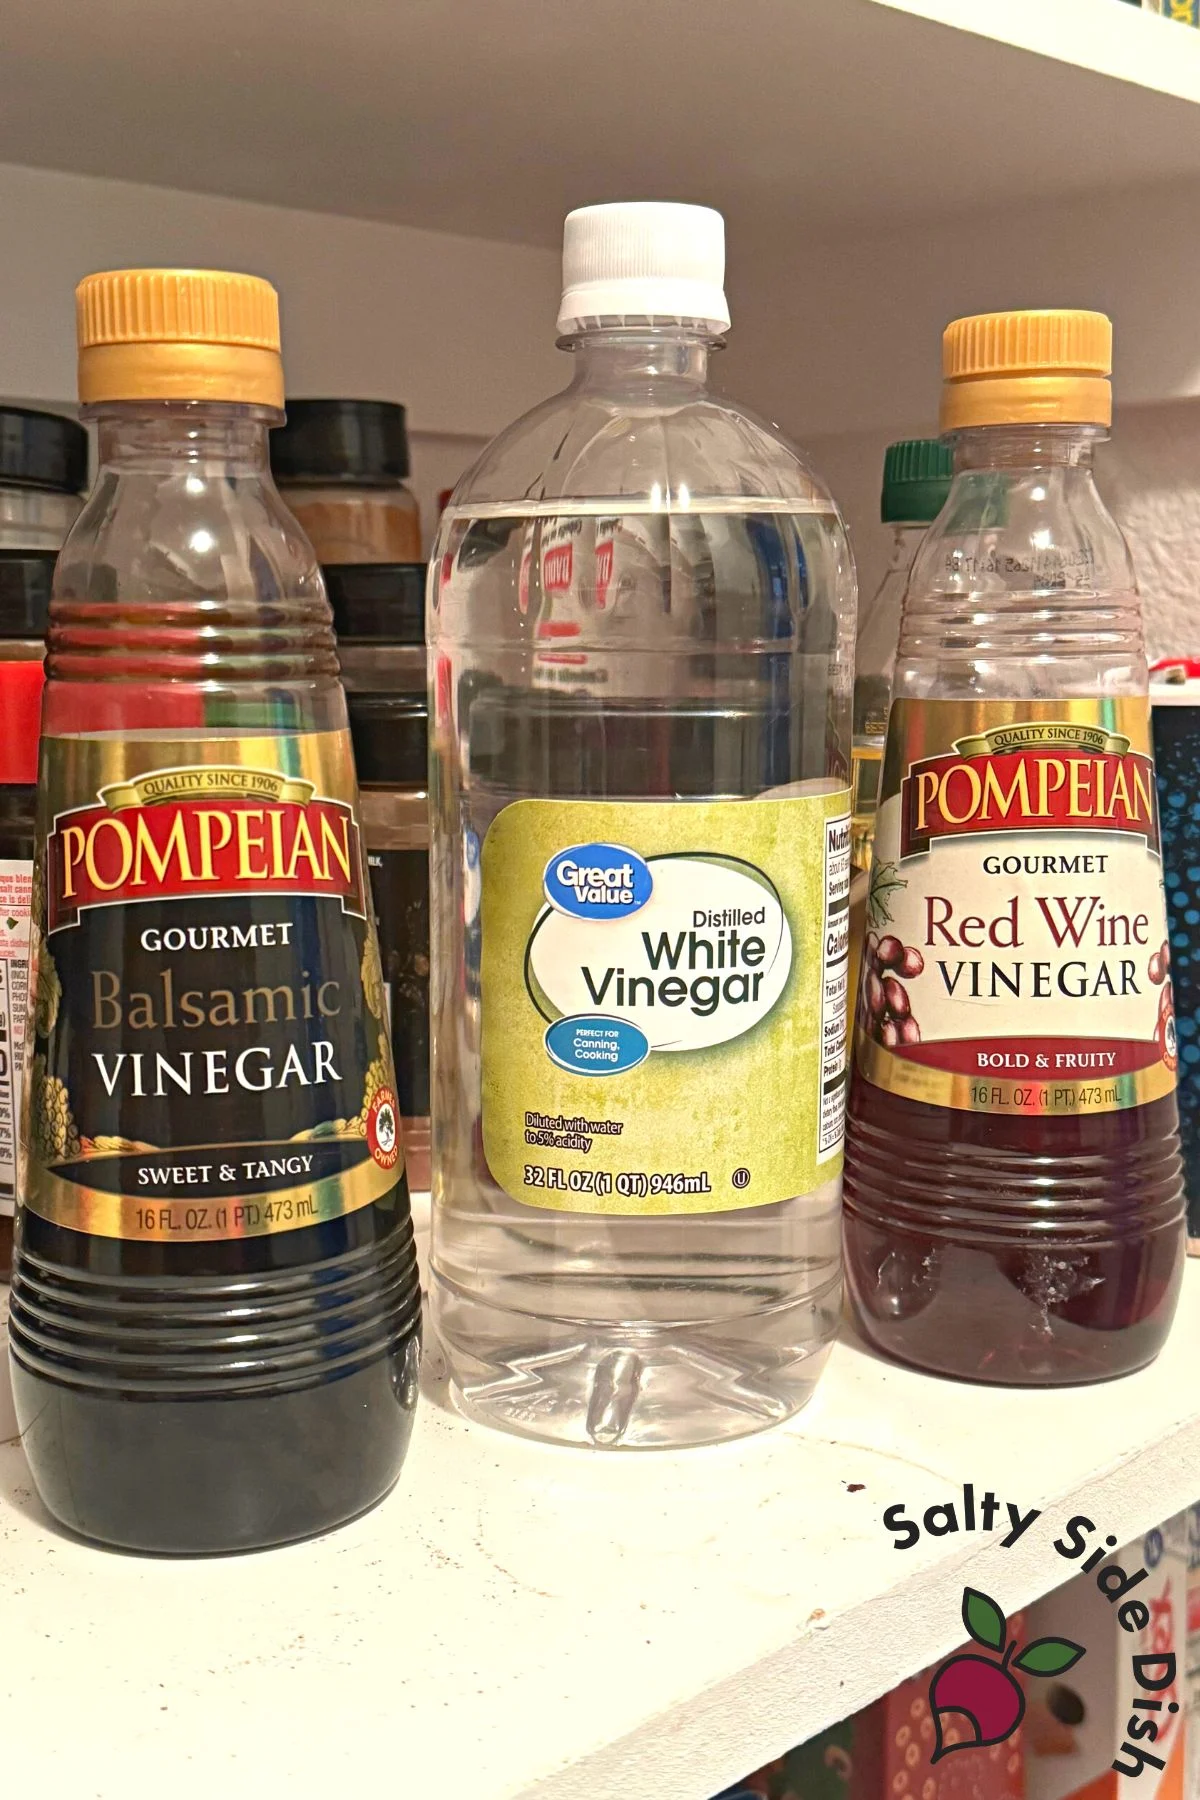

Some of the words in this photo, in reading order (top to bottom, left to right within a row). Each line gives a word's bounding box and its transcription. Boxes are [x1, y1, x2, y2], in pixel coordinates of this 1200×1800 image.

[993, 728, 1044, 745] QUALITY
[1047, 728, 1080, 740] SINCE
[1083, 730, 1104, 745] 1906
[143, 773, 203, 794] QUALITY
[207, 773, 247, 787] SINCE
[251, 775, 278, 793] 1906
[915, 757, 1153, 831] POMPEIAN
[60, 809, 352, 899] POMPEIAN
[983, 855, 1109, 874] GOURMET
[557, 860, 634, 887] Great
[573, 885, 634, 904] Value
[693, 907, 766, 928] Distilled
[924, 895, 1023, 948] Red
[1034, 896, 1149, 949] Wine
[141, 922, 293, 951] GOURMET
[641, 931, 765, 970] White
[581, 966, 765, 1017] Vinegar
[935, 960, 1142, 998] VINEGAR
[92, 968, 341, 1031] Balsamic
[573, 1038, 621, 1051] Canning,
[576, 1029, 603, 1039] PERFECT
[604, 1030, 619, 1039] FOR
[93, 1041, 343, 1097] VINEGAR
[574, 1049, 619, 1062] Cooking
[977, 1053, 1029, 1068] BOLD
[1035, 1053, 1049, 1068] &
[1055, 1051, 1116, 1067] FRUITY
[970, 1086, 987, 1103] 16
[991, 1087, 1010, 1105] FL.
[1014, 1088, 1035, 1105] OZ.
[1038, 1089, 1048, 1106] (1
[1079, 1087, 1101, 1104] 473
[1104, 1085, 1121, 1102] mL
[525, 1112, 564, 1130] Diluted
[564, 1117, 588, 1133] with
[590, 1120, 623, 1135] water
[525, 1130, 538, 1144] to
[537, 1133, 554, 1147] 5%
[555, 1135, 592, 1153] acidity
[138, 1165, 212, 1186] SWEET
[219, 1165, 237, 1180] &
[242, 1155, 314, 1179] TANGY
[524, 1165, 544, 1186] 32
[546, 1168, 567, 1189] FL
[569, 1171, 593, 1191] OZ
[594, 1172, 612, 1195] (1
[616, 1173, 648, 1196] QT)
[650, 1171, 711, 1195] 946mL
[136, 1211, 155, 1229] 16
[159, 1211, 182, 1232] FL.
[185, 1211, 213, 1228] OZ.
[217, 1209, 228, 1231] (1
[264, 1202, 292, 1224] 473
[296, 1200, 318, 1221] mL
